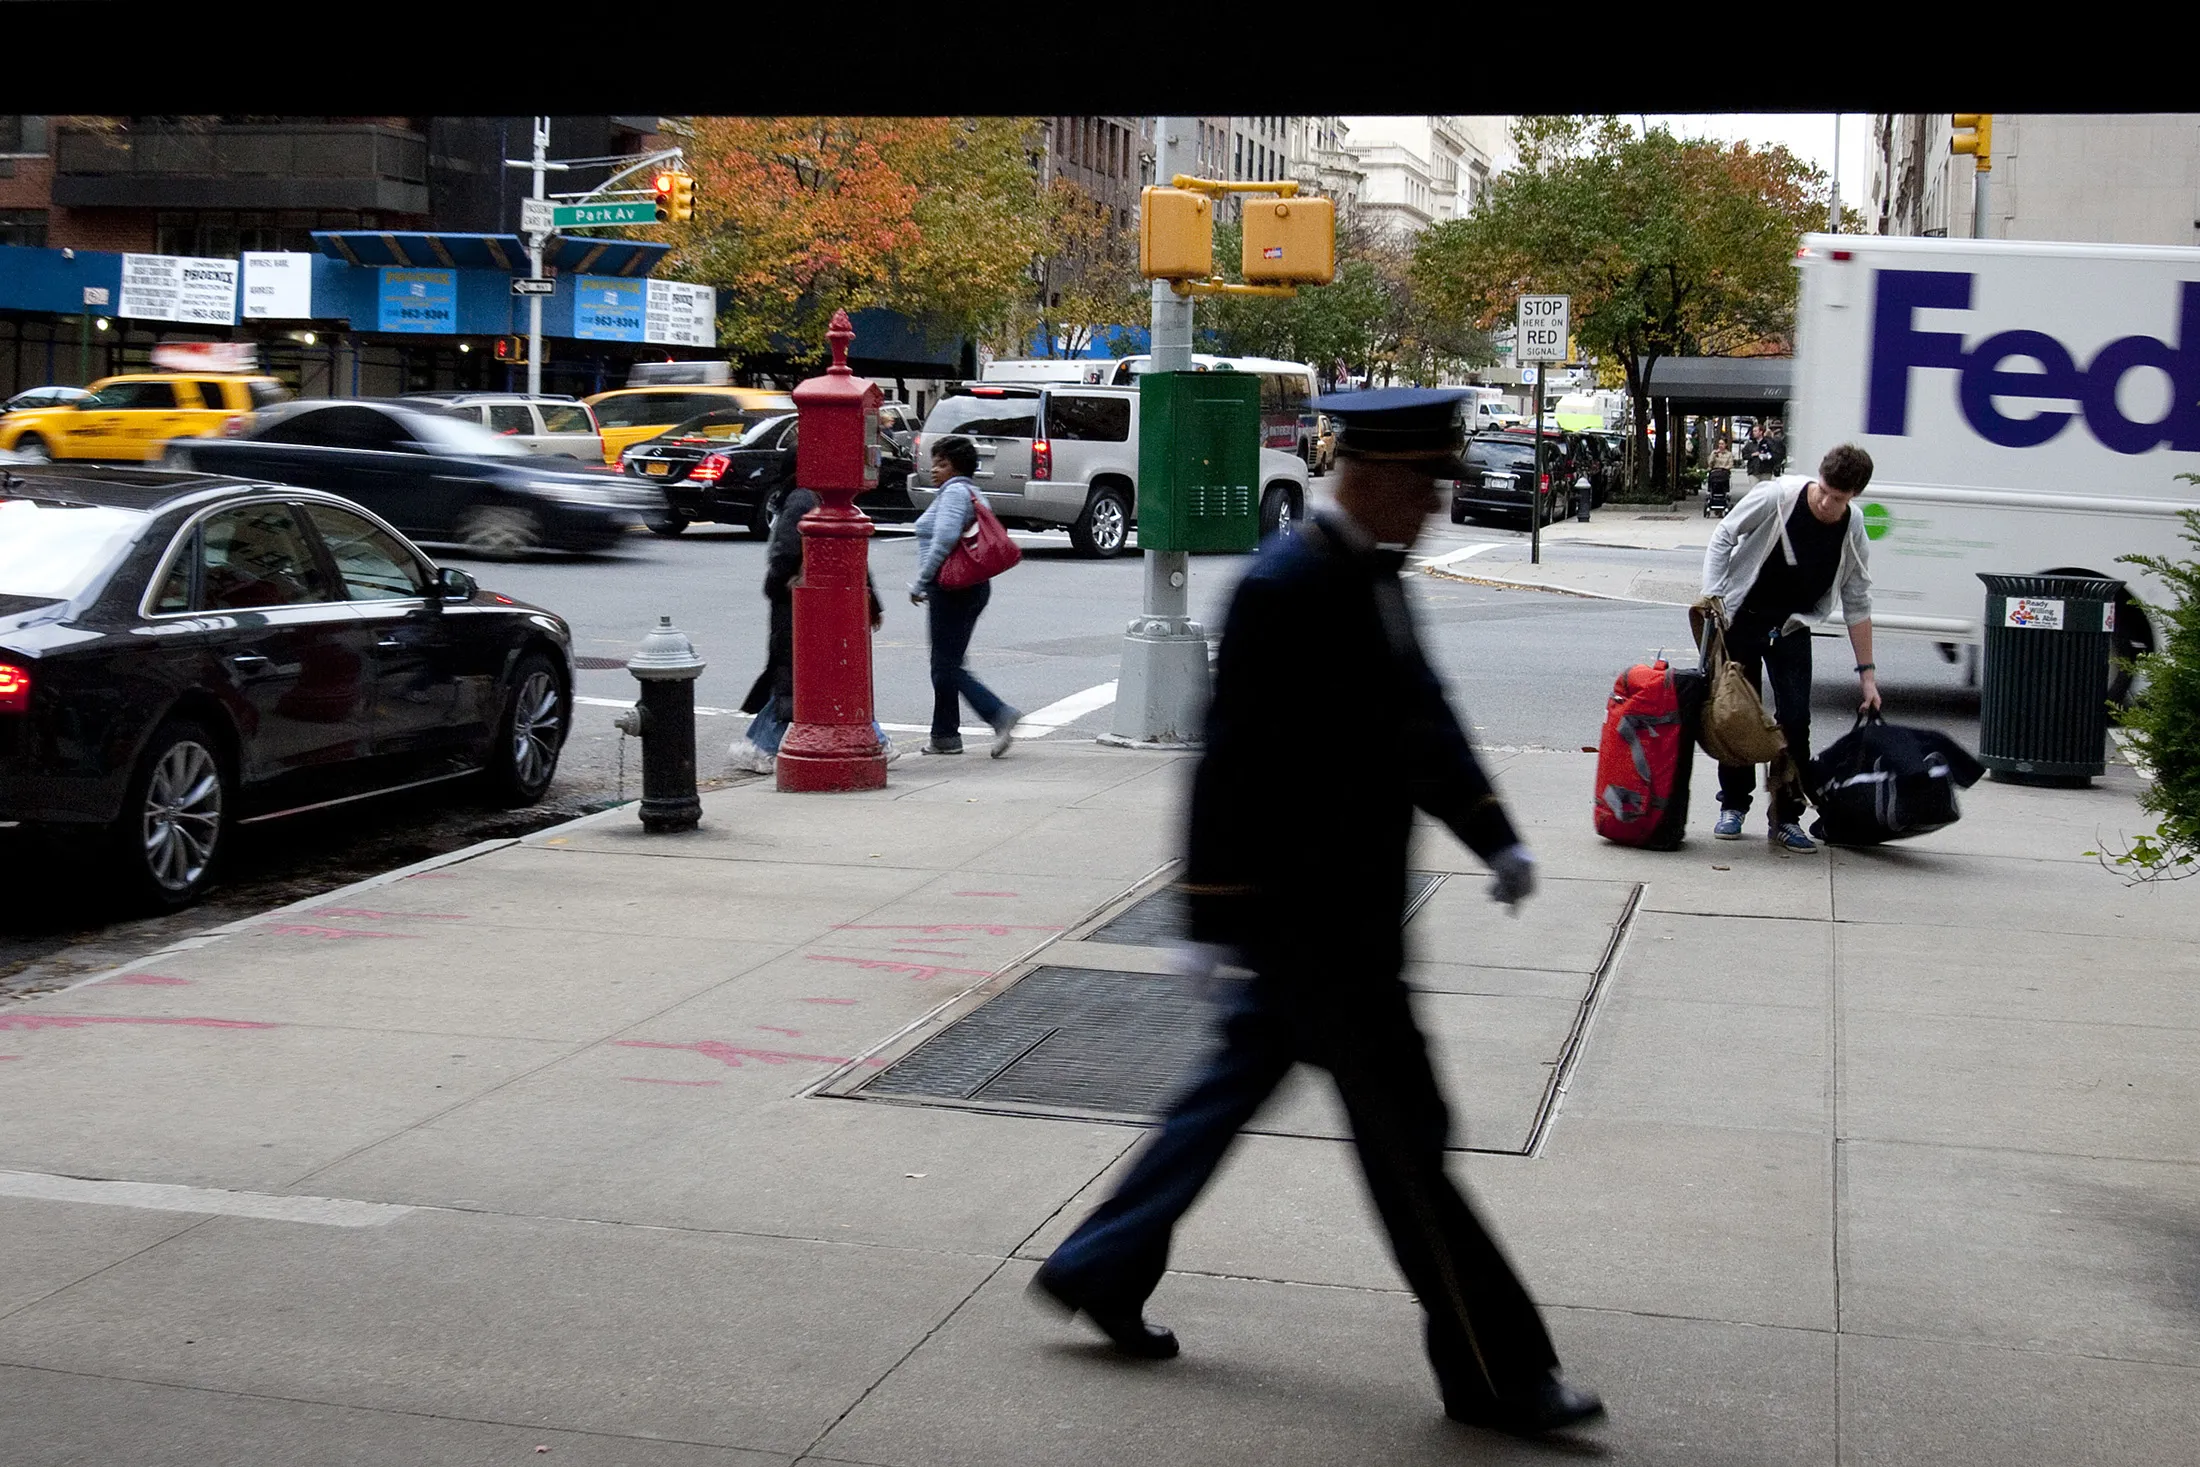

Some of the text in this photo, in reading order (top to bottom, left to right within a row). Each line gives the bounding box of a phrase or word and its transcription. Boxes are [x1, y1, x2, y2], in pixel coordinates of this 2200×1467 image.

[575, 207, 635, 222] Park Av
[183, 269, 234, 284] PHOENIX
[1524, 301, 1562, 316] STOP
[1522, 318, 1563, 327] HERE ON
[1527, 330, 1557, 344] RED
[1526, 347, 1557, 356] SIGNAL
[1864, 268, 2200, 455] Fed
[2025, 600, 2048, 608] Ready
